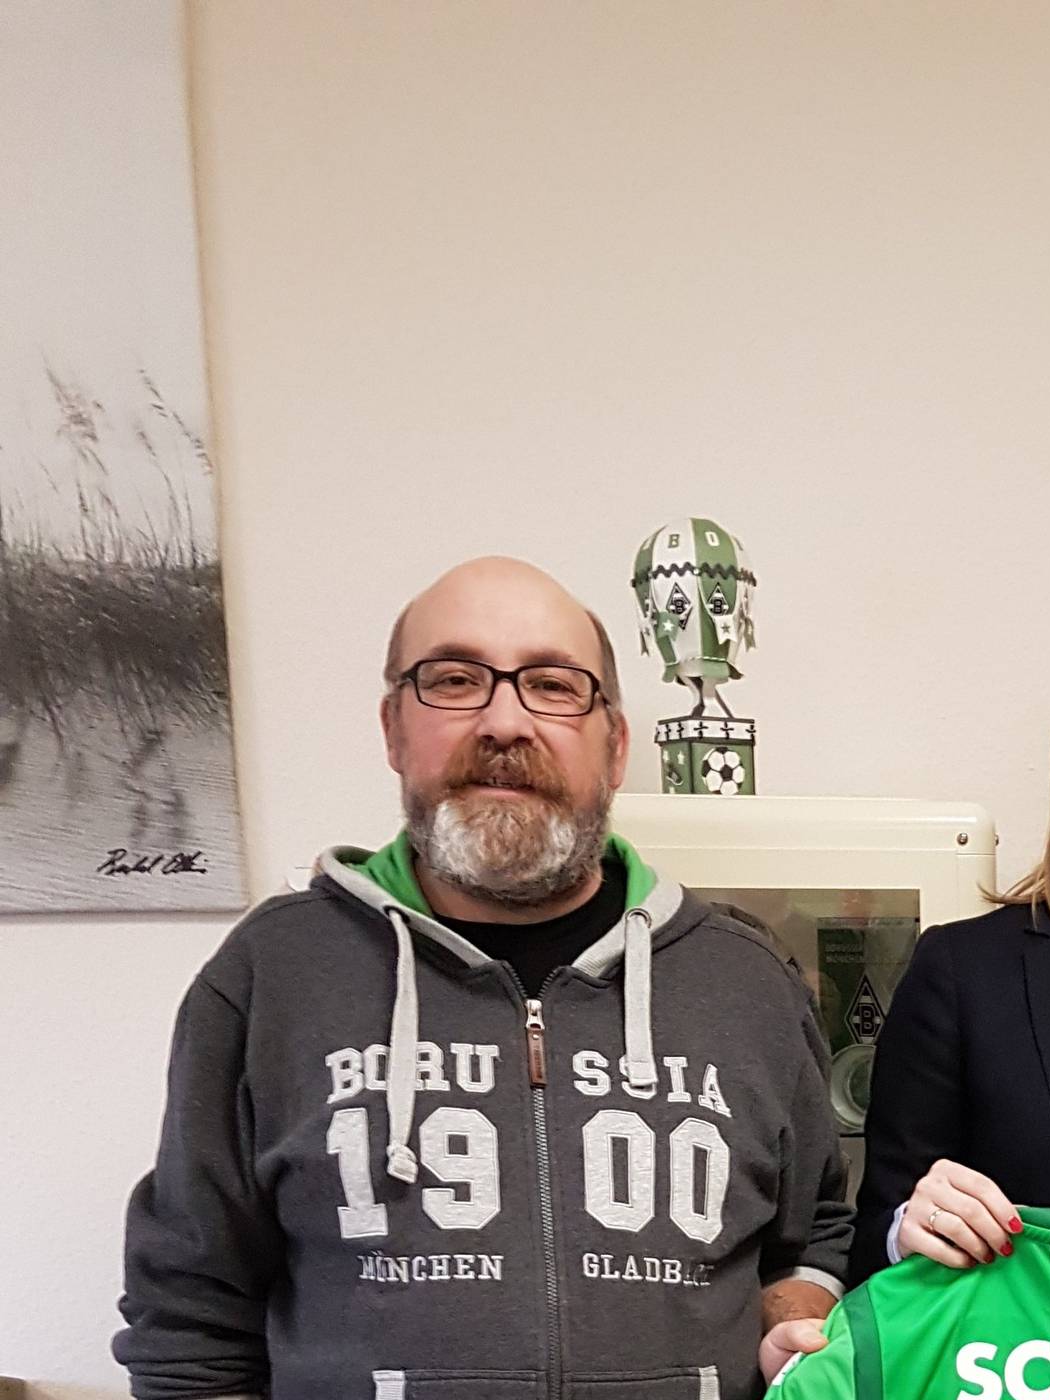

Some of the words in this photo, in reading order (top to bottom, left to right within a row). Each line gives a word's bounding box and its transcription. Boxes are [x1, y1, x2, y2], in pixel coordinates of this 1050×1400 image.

[326, 1107, 500, 1239] 19
[582, 1109, 730, 1244] 00
[582, 1252, 715, 1287] GLADB
